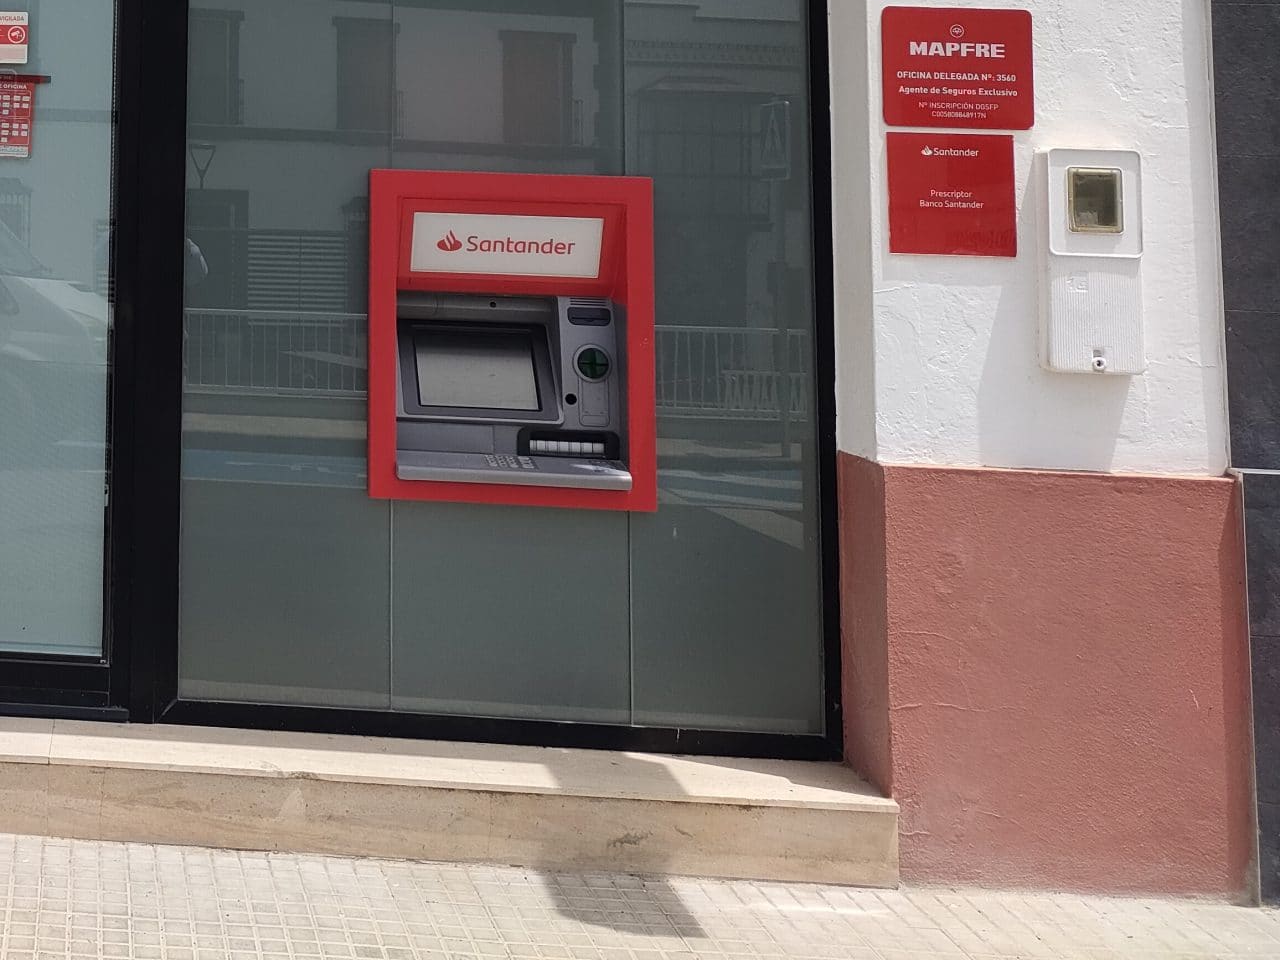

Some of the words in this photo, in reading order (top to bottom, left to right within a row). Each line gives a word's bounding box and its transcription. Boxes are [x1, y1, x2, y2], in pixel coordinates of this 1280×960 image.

[909, 41, 1006, 59] MAPFRE
[896, 71, 932, 80] OFICINA
[934, 72, 980, 81] DELEGADA
[996, 74, 1016, 82] 3560
[898, 86, 929, 94] Agente
[930, 86, 941, 94] de
[942, 86, 977, 97] Seguros
[978, 88, 1018, 97] Exclusivo
[930, 101, 974, 110] INSCRIPCIÓN
[933, 147, 980, 158] Santander
[930, 190, 972, 200] Prescriptor
[919, 200, 944, 209] Banco
[944, 200, 984, 210] Santander
[466, 235, 576, 256] Santander
